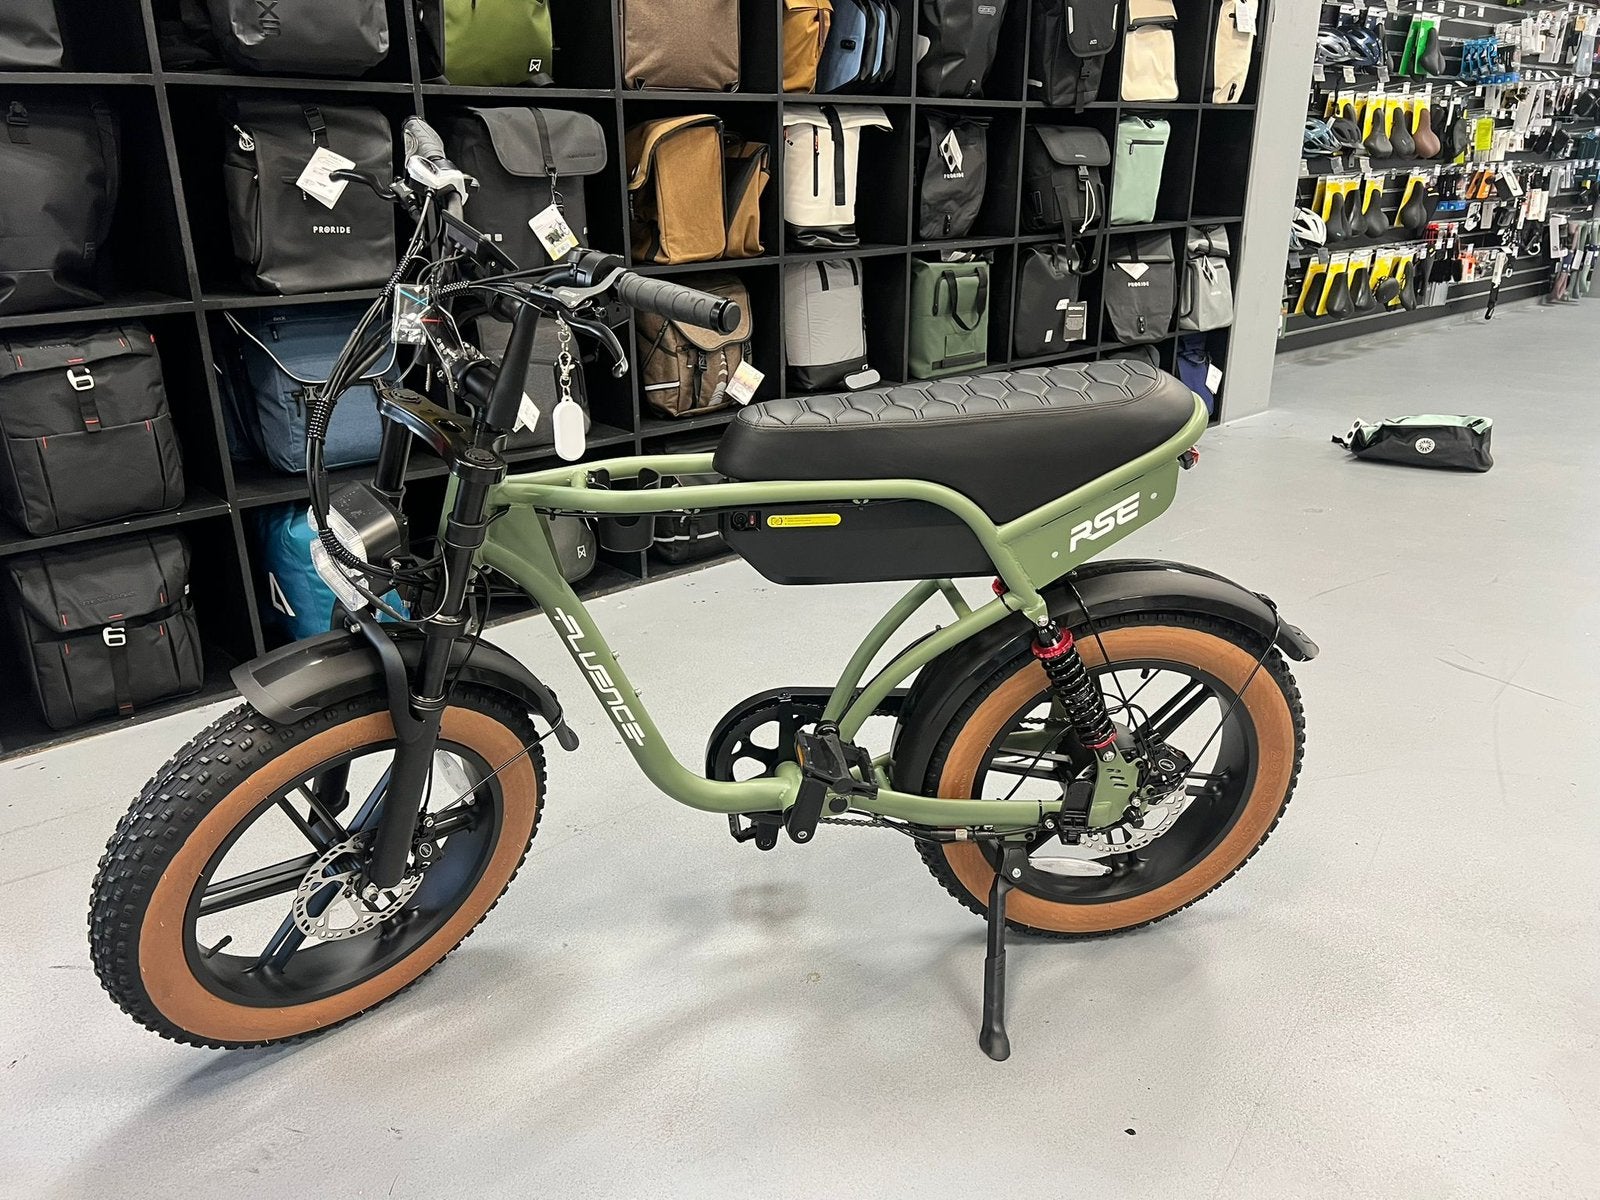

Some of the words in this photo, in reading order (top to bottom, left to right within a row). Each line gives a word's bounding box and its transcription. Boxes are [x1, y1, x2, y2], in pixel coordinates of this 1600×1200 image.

[313, 226, 351, 234] PRORIDE
[1069, 491, 1140, 553] RSE
[553, 607, 646, 747] FLUENCE
